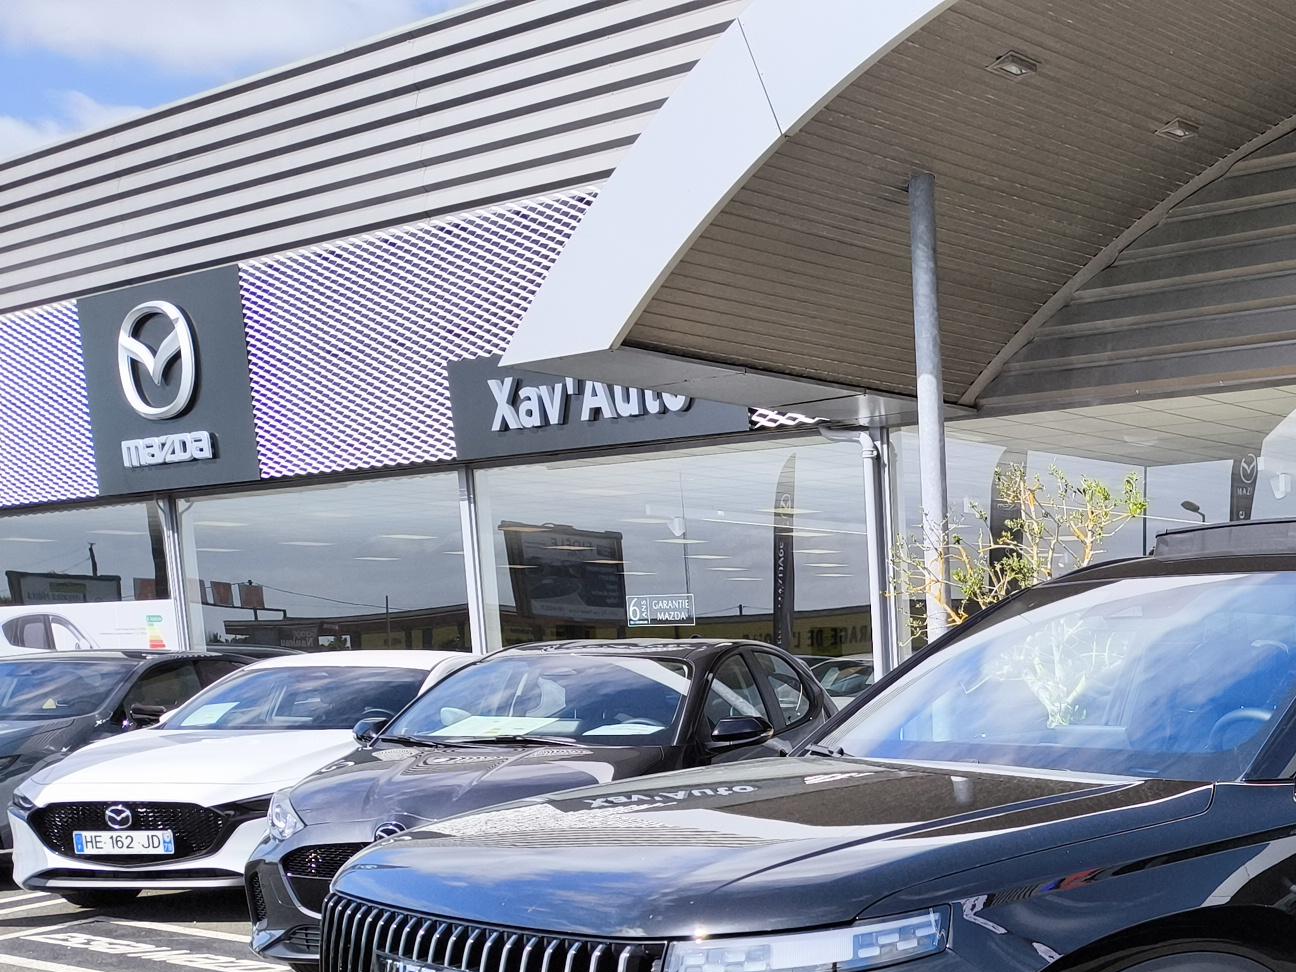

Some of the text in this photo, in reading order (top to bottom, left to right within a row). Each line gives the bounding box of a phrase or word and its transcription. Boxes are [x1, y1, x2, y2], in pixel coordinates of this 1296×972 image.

[487, 376, 690, 431] Xav'Auto
[629, 598, 640, 621] 6
[652, 600, 690, 609] GARANTIE
[657, 611, 686, 621] MAZDA
